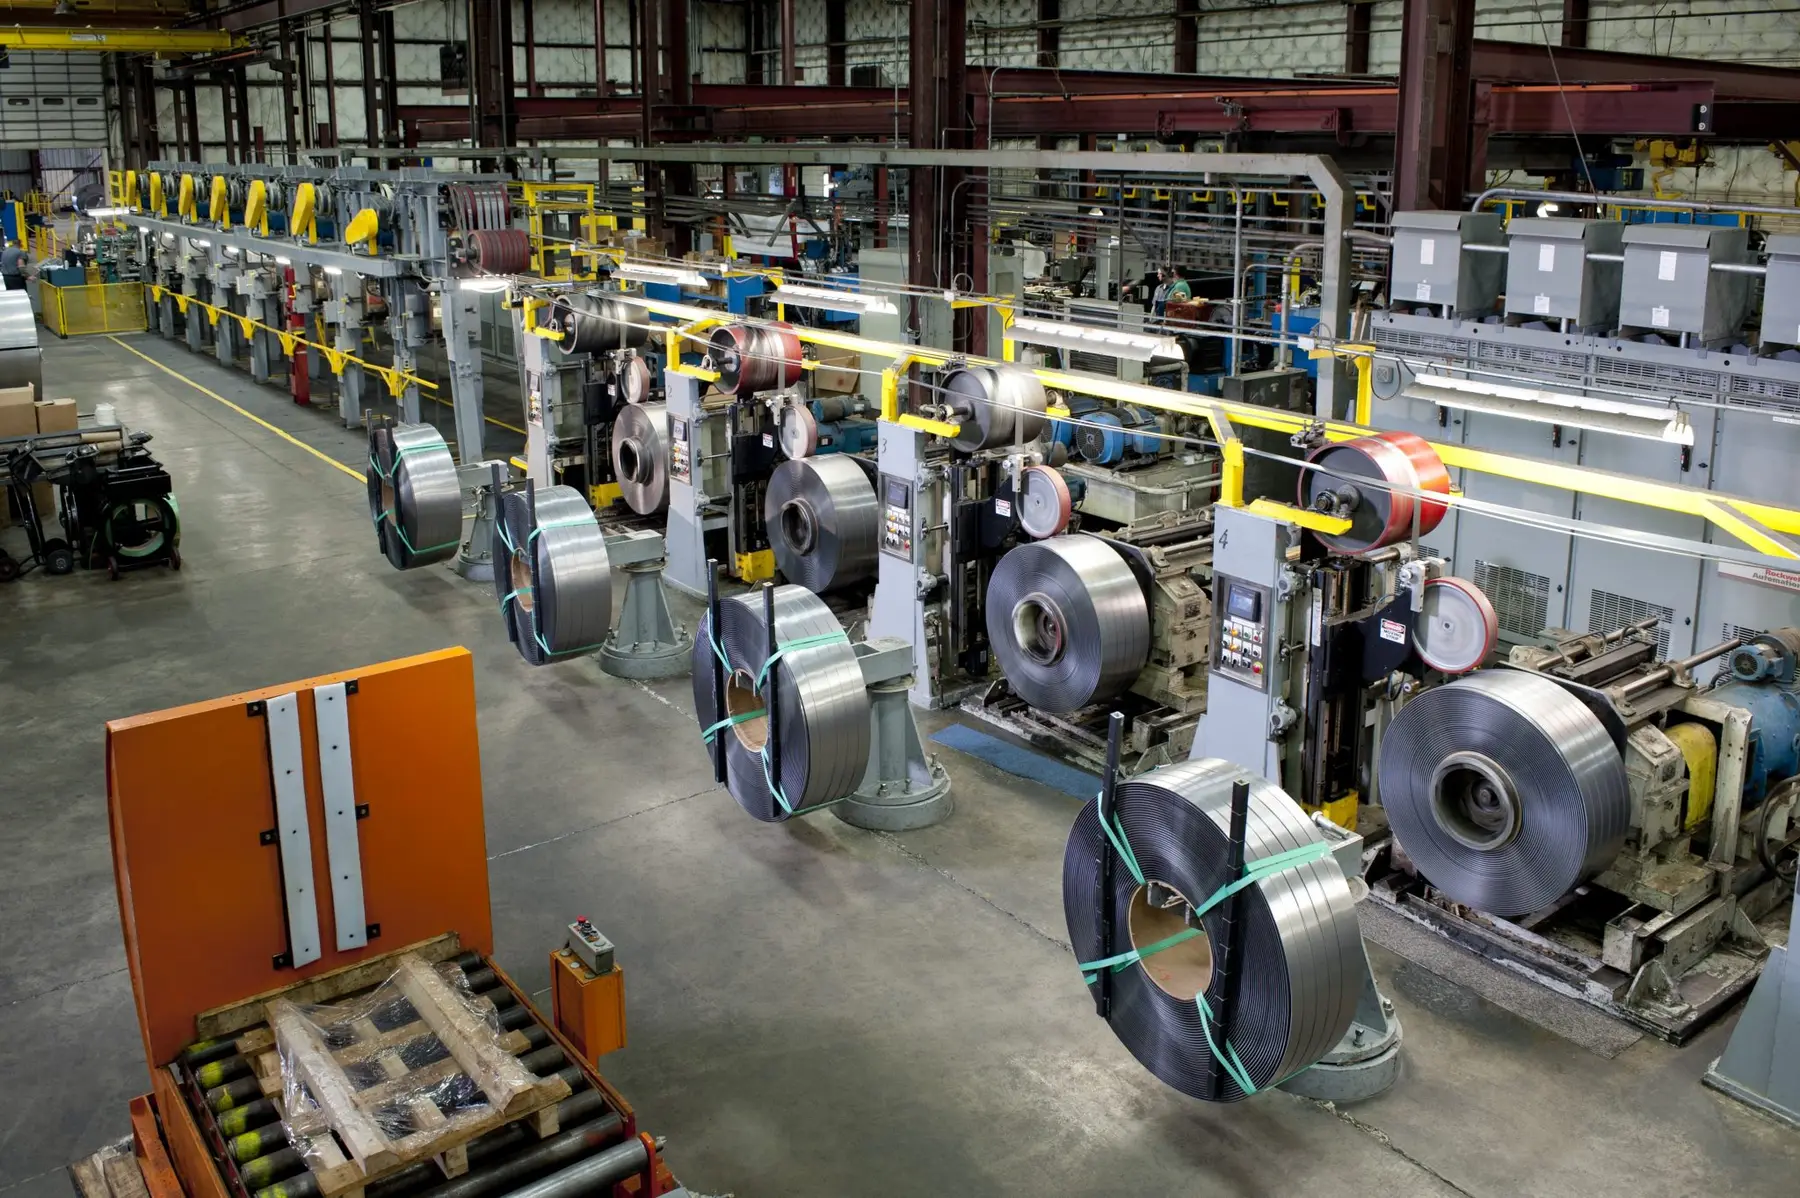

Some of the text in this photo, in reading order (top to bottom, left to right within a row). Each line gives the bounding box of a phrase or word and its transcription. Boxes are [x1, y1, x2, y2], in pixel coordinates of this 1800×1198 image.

[667, 385, 673, 398] 2
[881, 438, 888, 454] 3
[1218, 529, 1229, 550] 4
